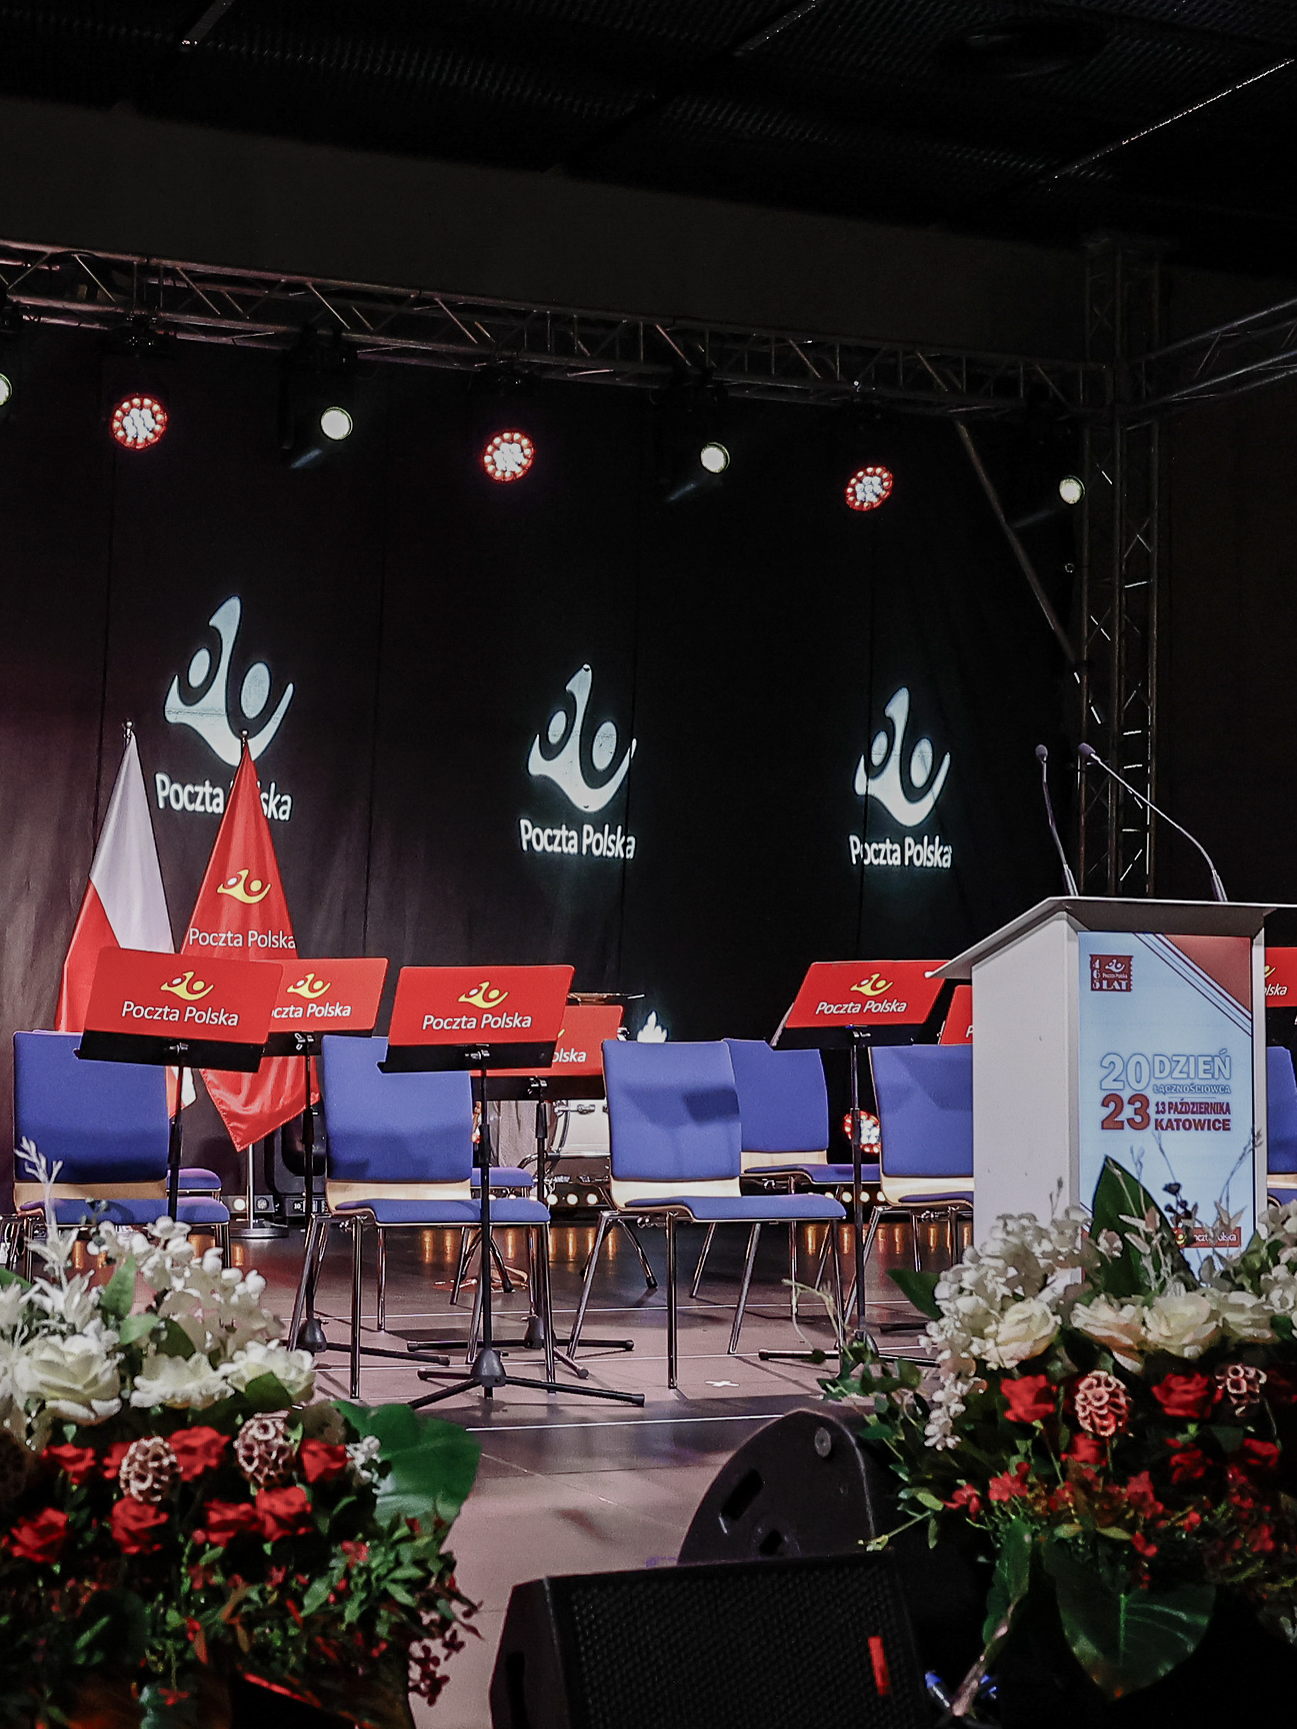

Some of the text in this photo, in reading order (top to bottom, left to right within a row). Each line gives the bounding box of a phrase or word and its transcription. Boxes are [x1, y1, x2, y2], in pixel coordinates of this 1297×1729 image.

[155, 773, 225, 814] Poczta
[520, 818, 636, 859] Poczta Polska
[849, 834, 952, 868] Poczta Polska
[189, 928, 296, 949] Poczta Polska
[1264, 983, 1288, 996] lska
[122, 1001, 239, 1027] Poczta Polska
[272, 1002, 351, 1018] czta Polska
[815, 999, 907, 1015] Poczta Polska
[422, 1012, 532, 1030] Poczta Polska
[552, 1048, 587, 1063] olska
[1152, 1048, 1231, 1080] DZIEŃ
[1100, 1052, 1151, 1092] 20
[1153, 1082, 1231, 1095] ŁĄCZNOŚCIOWCA
[1101, 1093, 1151, 1130] 23
[1155, 1098, 1231, 1115] 13 PAŹDZIERNIKA
[1154, 1118, 1231, 1131] KATOWICE
